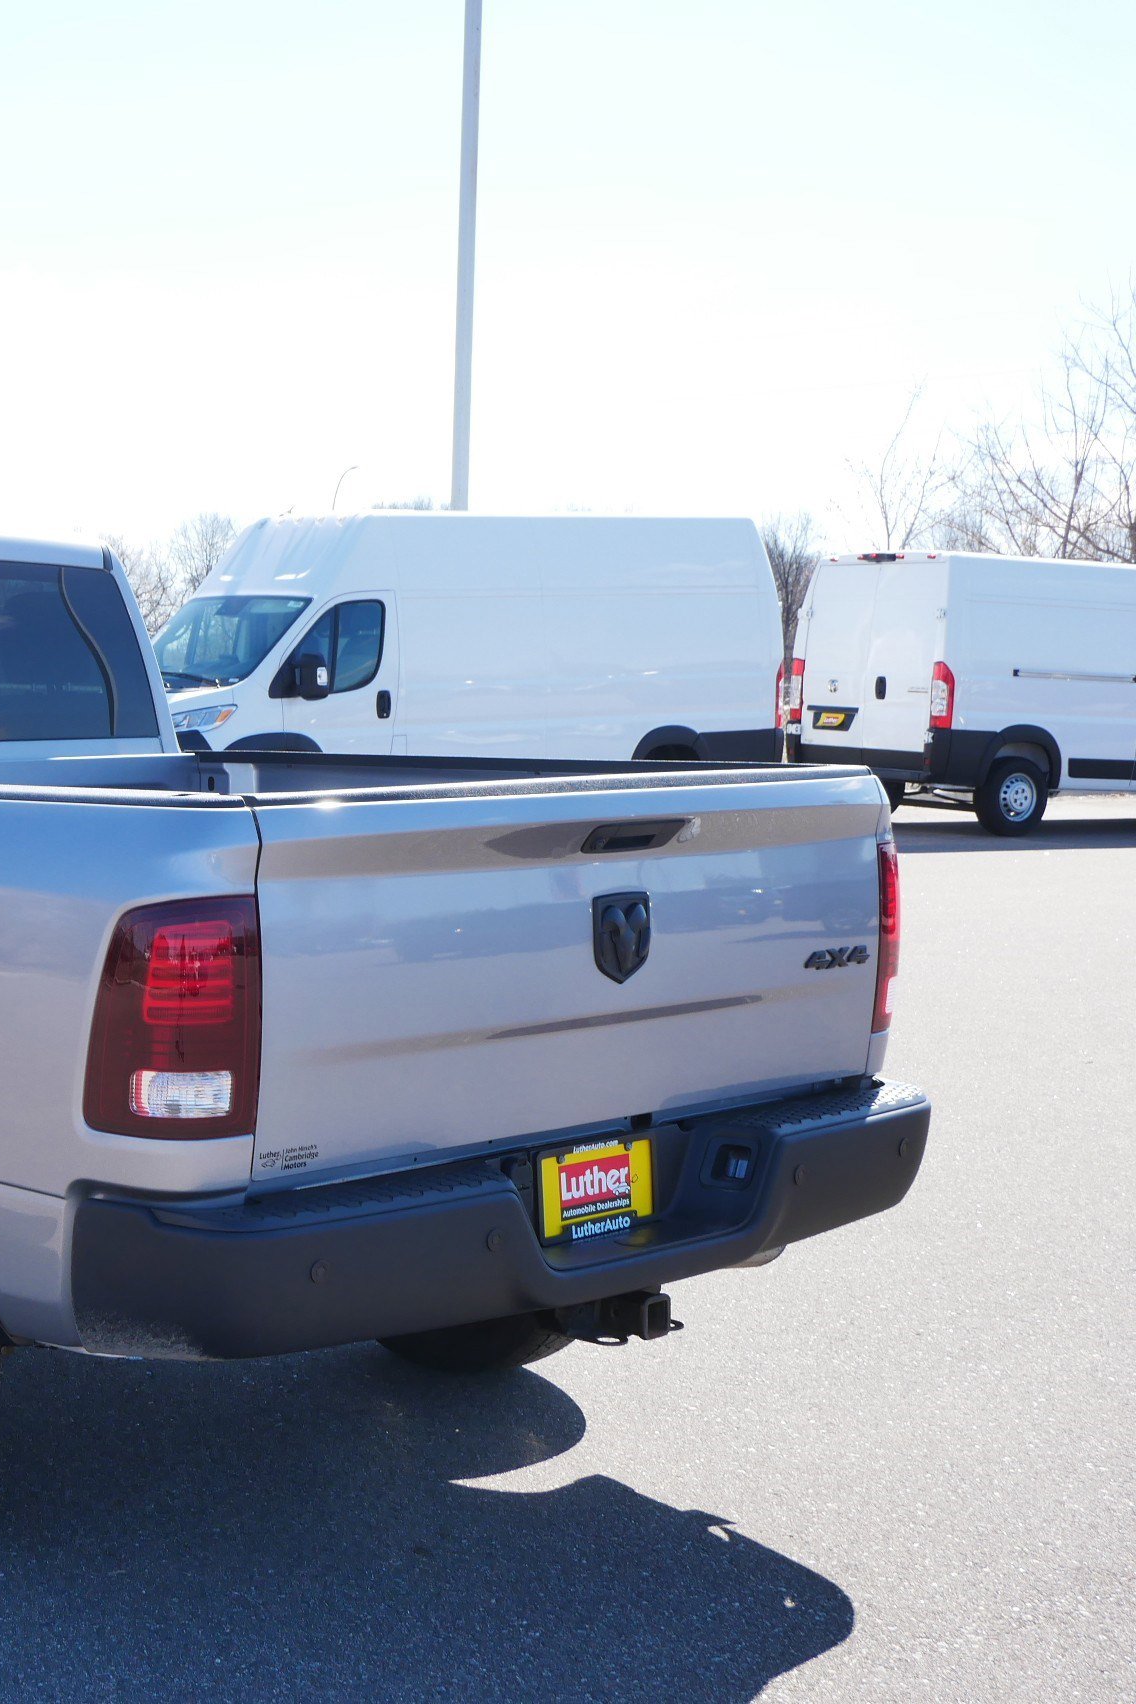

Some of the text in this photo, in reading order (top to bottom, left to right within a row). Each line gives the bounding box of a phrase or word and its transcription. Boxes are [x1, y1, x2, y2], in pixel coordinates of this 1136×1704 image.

[803, 945, 871, 971] 4X4
[285, 1147, 298, 1155] John
[573, 1140, 619, 1154] LutherAuto.com
[284, 1151, 319, 1162] Cambridge
[284, 1161, 307, 1170] Motors
[561, 1165, 629, 1201] Luther
[563, 1198, 630, 1218] Automobile Dealerships
[572, 1216, 631, 1239] LutherAuto
